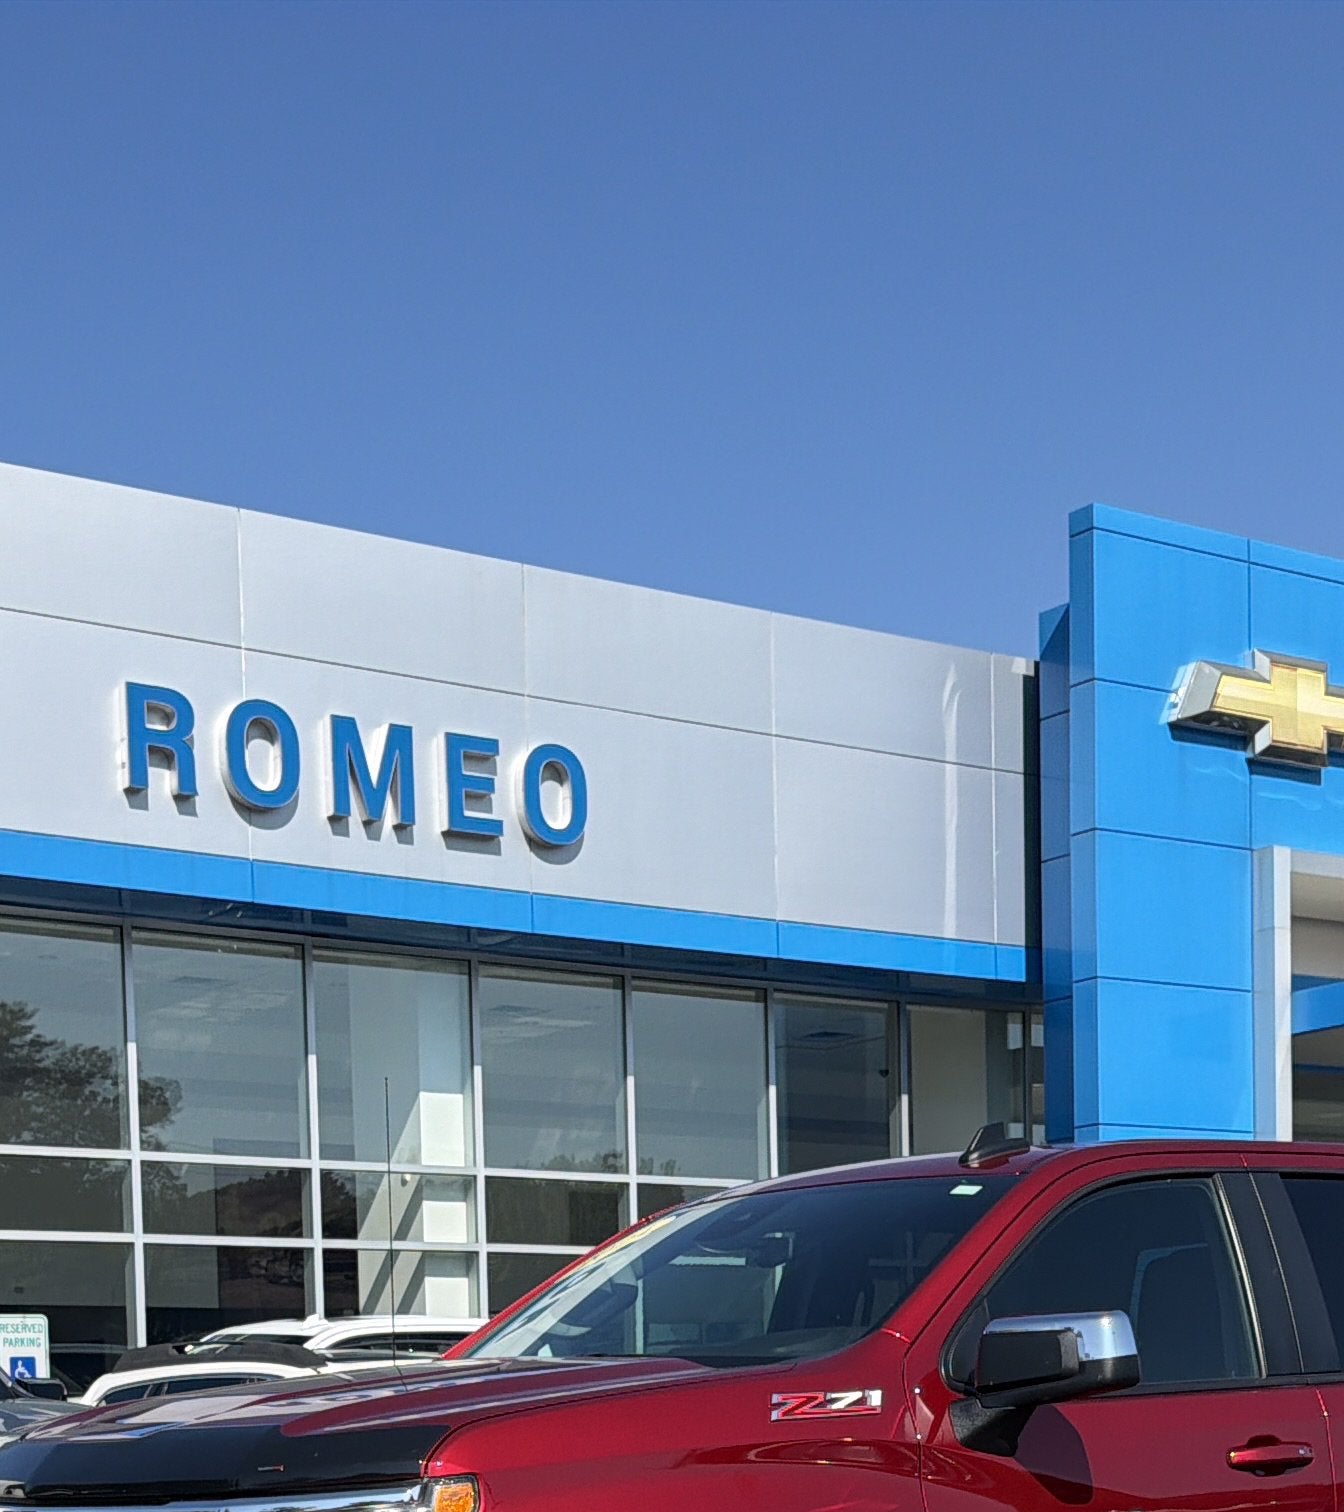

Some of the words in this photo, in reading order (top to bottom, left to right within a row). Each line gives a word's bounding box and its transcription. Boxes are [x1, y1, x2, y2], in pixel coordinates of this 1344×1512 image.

[123, 680, 588, 847] ROMEO
[0, 1323, 44, 1334] RESERVED
[2, 1337, 42, 1348] PARKING
[771, 1389, 883, 1421] Z71
